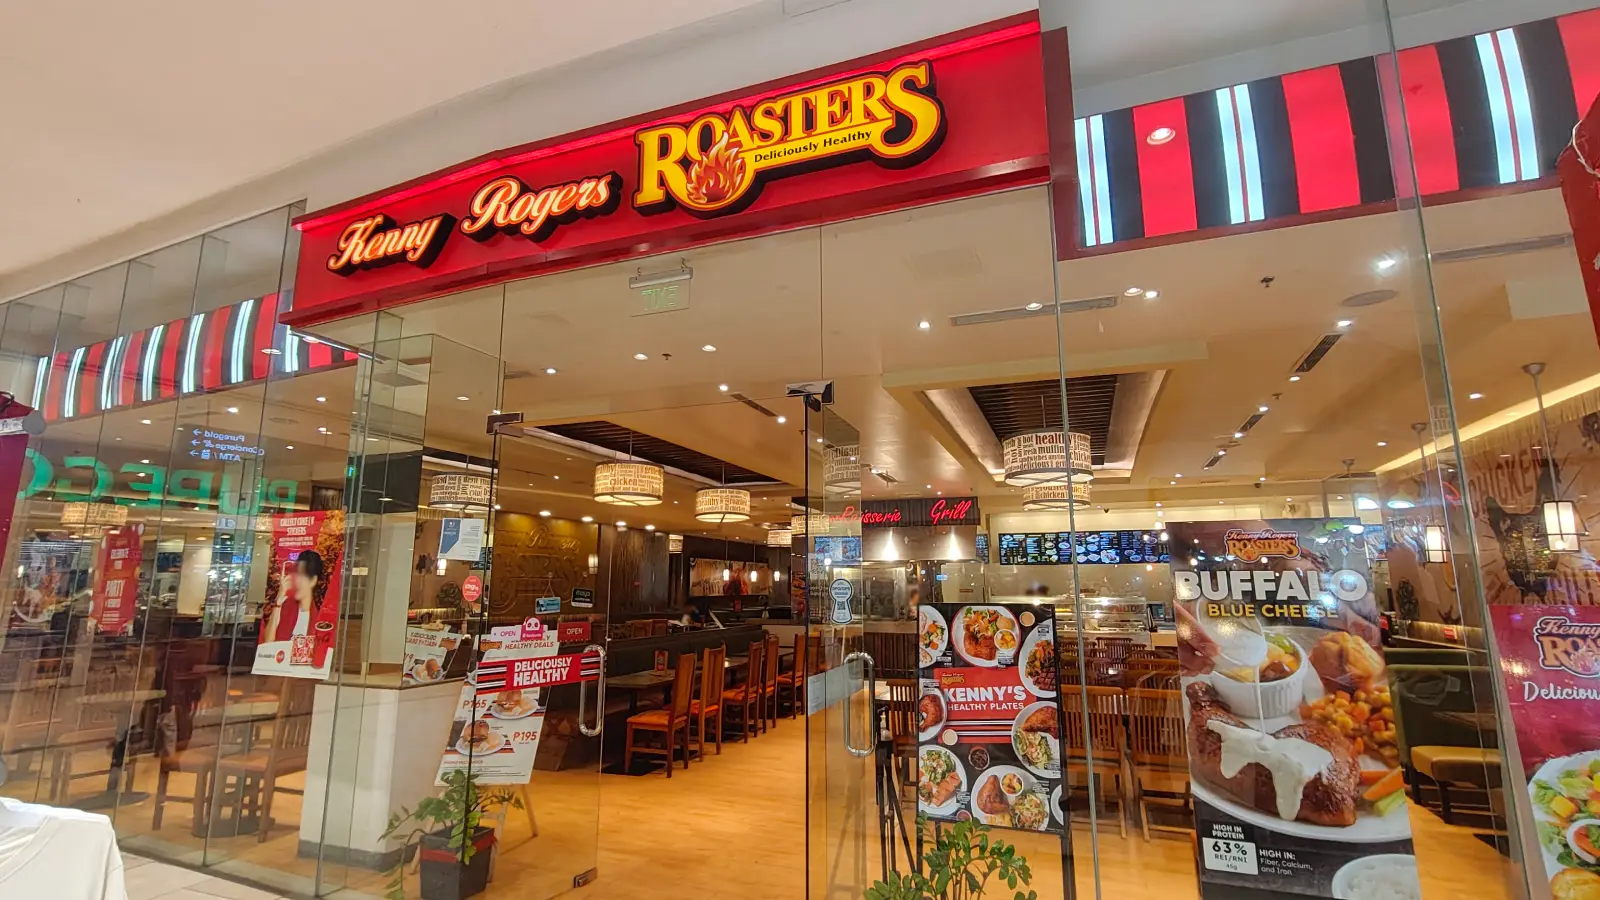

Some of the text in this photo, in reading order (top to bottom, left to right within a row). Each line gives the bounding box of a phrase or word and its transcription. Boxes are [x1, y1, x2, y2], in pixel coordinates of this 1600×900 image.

[635, 61, 941, 211] ROASTERS
[753, 128, 873, 164] Deliciously Healthy
[327, 174, 613, 271] Kenny Rogers
[930, 499, 972, 525] Grill
[1227, 531, 1296, 540] Kenny Rogers
[1227, 539, 1299, 560] ROASTERS
[1174, 569, 1368, 601] BUFFALO
[1207, 603, 1339, 619] BLUE CHEESE
[566, 627, 584, 635] OPEN
[1539, 619, 1600, 638] Kenny
[504, 642, 532, 650] HEALTHY
[514, 657, 572, 672] DELICIOUSLY
[513, 667, 570, 687] HEALTHY
[943, 686, 1027, 702] KENNY'S
[1523, 681, 1600, 702] Deliciou
[948, 702, 1025, 711] HEALTHY PLATES
[1212, 830, 1245, 840] PROTEIN
[1213, 824, 1242, 833] HIGH IN
[1212, 840, 1248, 856] 63%
[1260, 849, 1296, 860] HIGH IN:
[1260, 858, 1313, 871] Fiber, Calcium,
[1277, 867, 1293, 876] Iron
